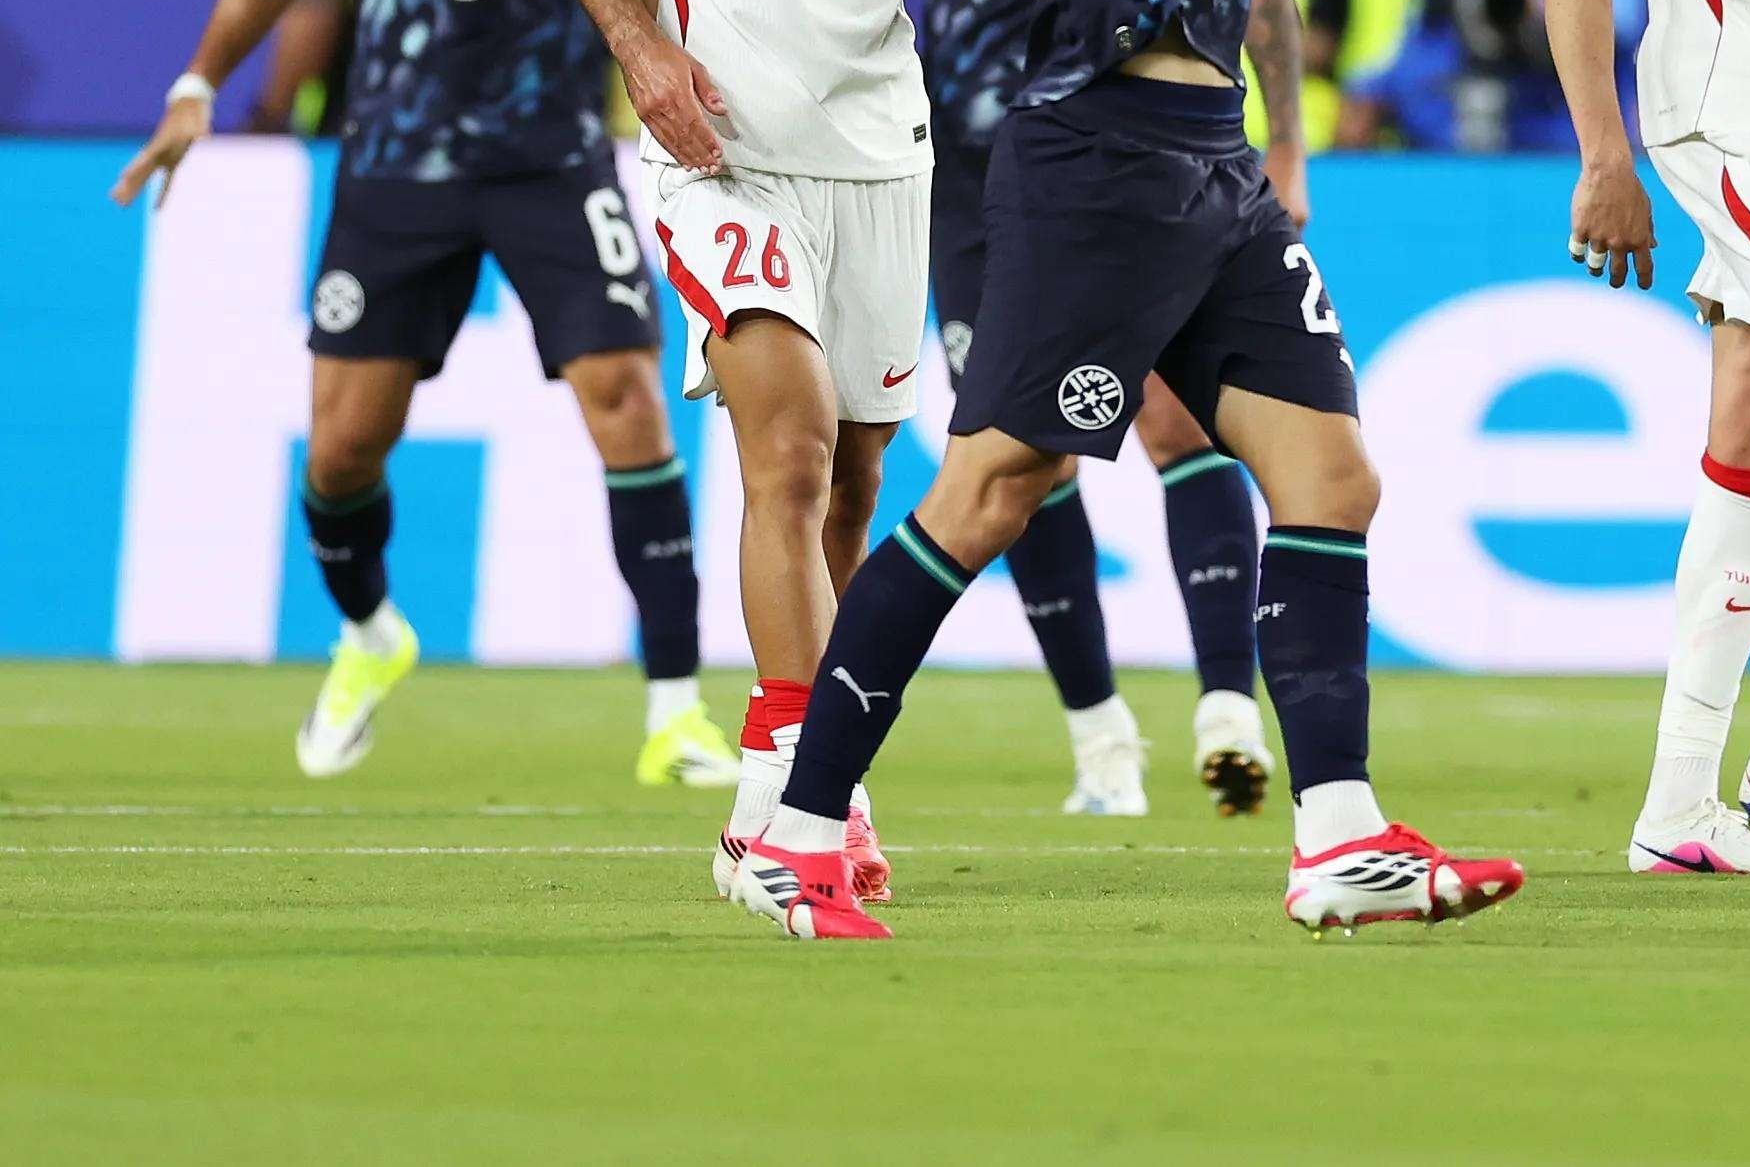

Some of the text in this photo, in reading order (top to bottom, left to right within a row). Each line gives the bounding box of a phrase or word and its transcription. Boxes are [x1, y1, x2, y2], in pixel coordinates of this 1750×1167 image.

[583, 186, 642, 277] 6
[714, 220, 794, 291] 26
[1282, 242, 1342, 335] 2
